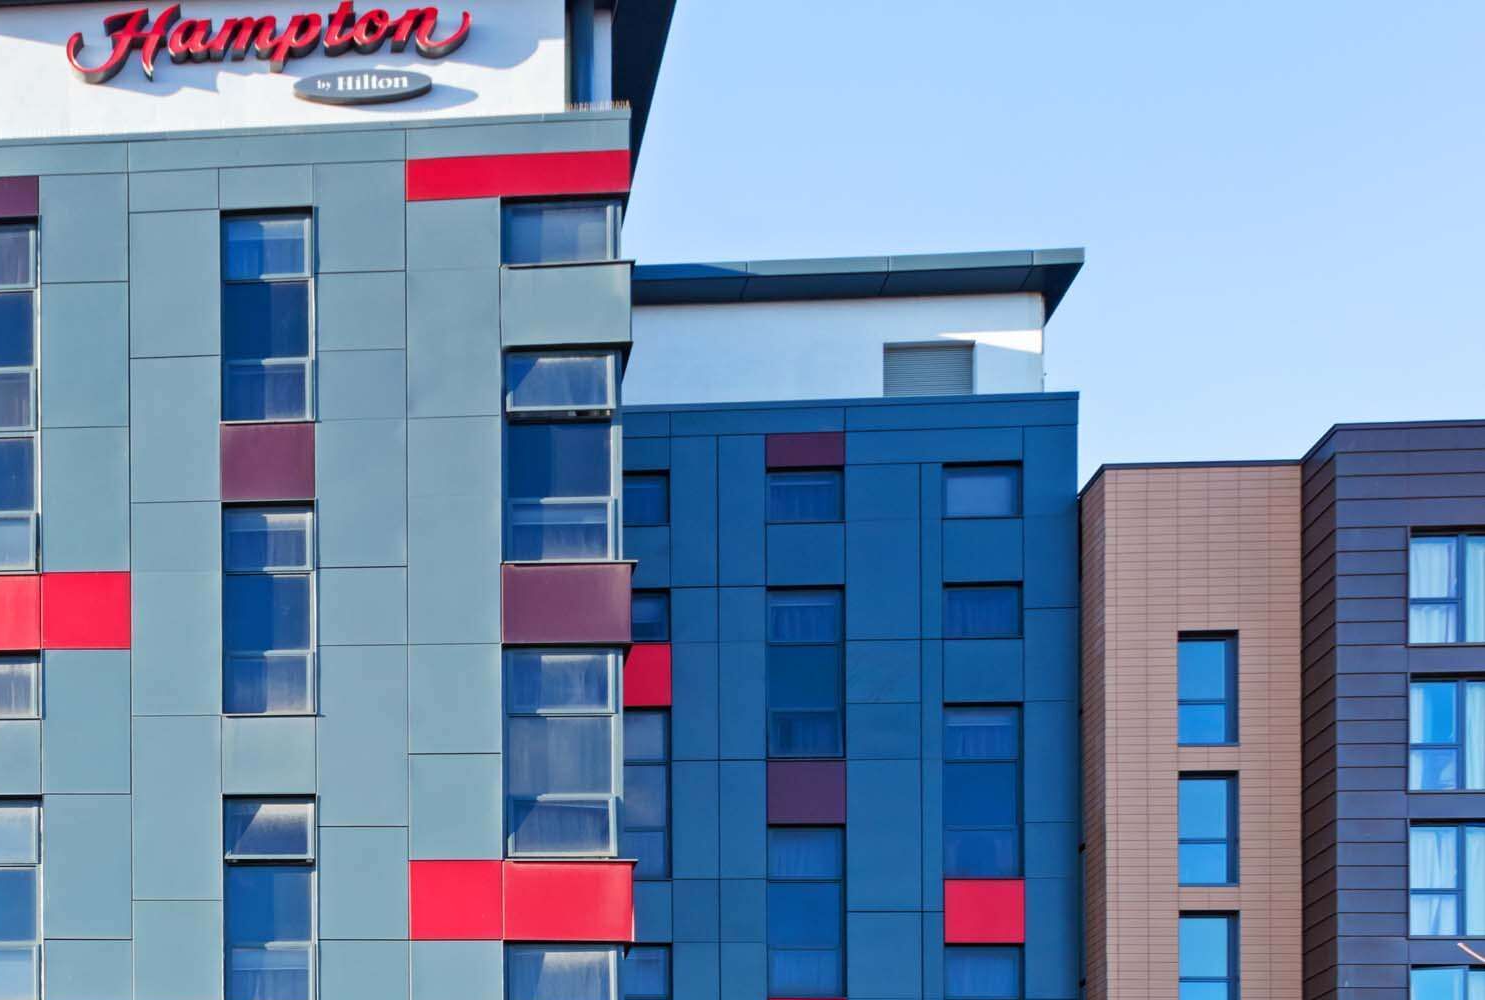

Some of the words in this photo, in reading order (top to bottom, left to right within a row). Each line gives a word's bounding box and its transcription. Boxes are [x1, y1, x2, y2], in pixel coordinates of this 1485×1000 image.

[66, 0, 472, 83] Hampton
[317, 80, 331, 91] by
[337, 73, 408, 91] Hilton
